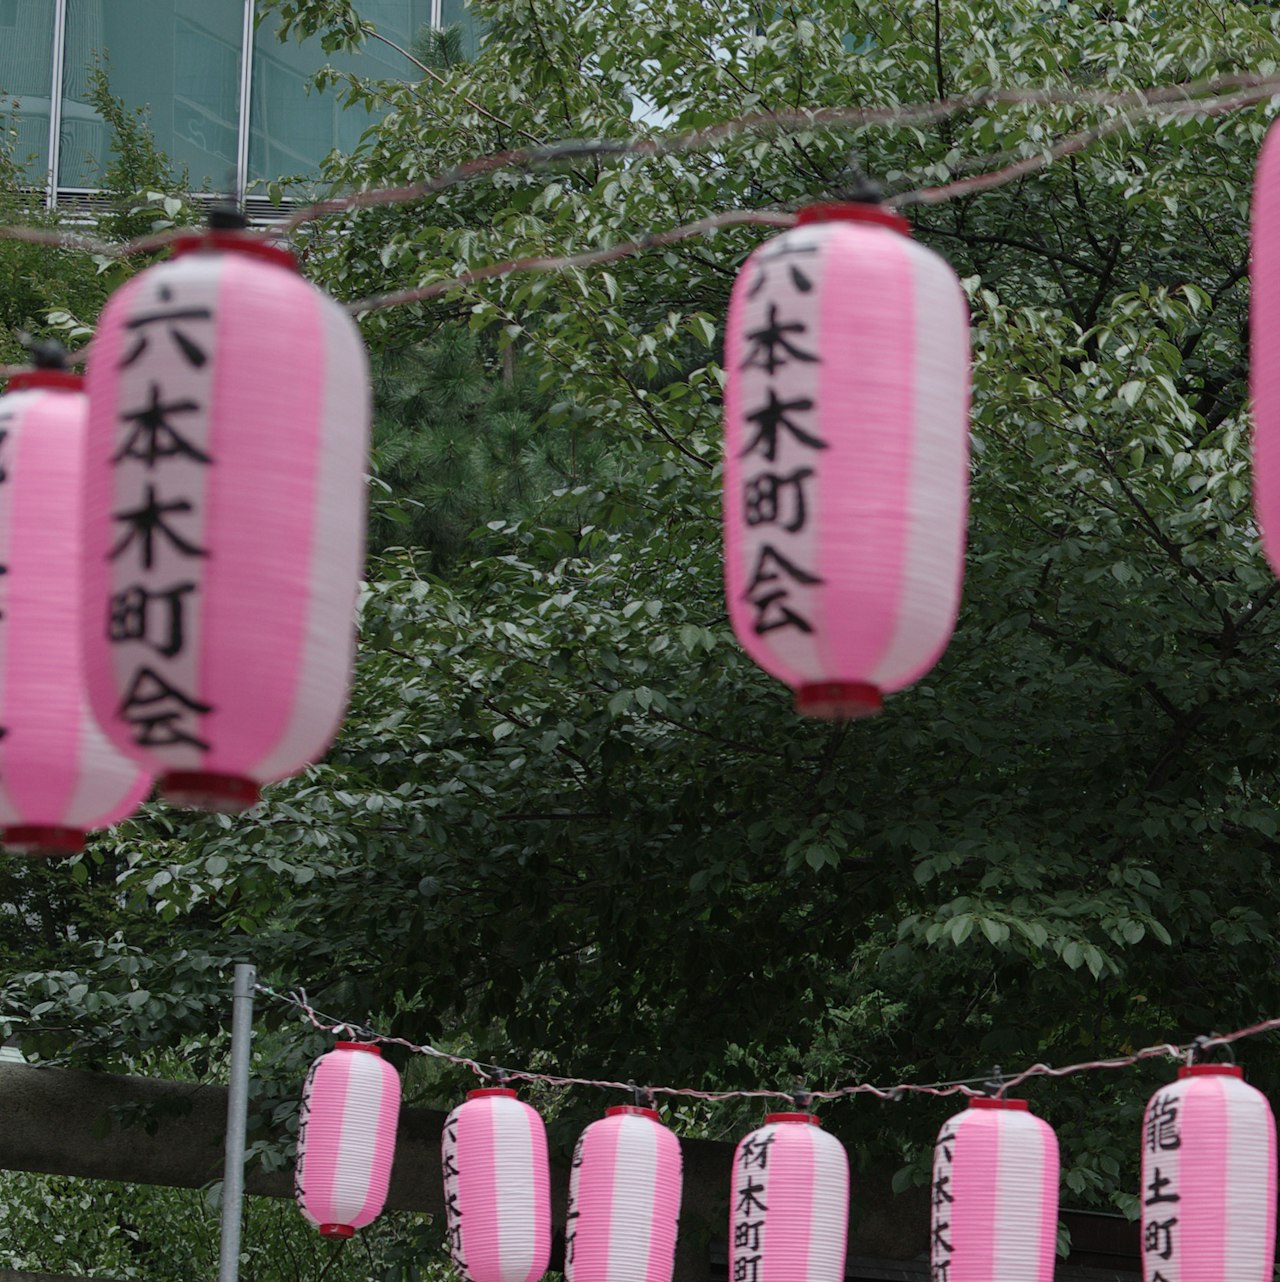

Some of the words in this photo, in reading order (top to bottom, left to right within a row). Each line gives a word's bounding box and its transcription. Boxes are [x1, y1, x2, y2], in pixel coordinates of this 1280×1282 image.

[106, 284, 214, 752] 六本木町会
[736, 230, 828, 638] 六本木町会
